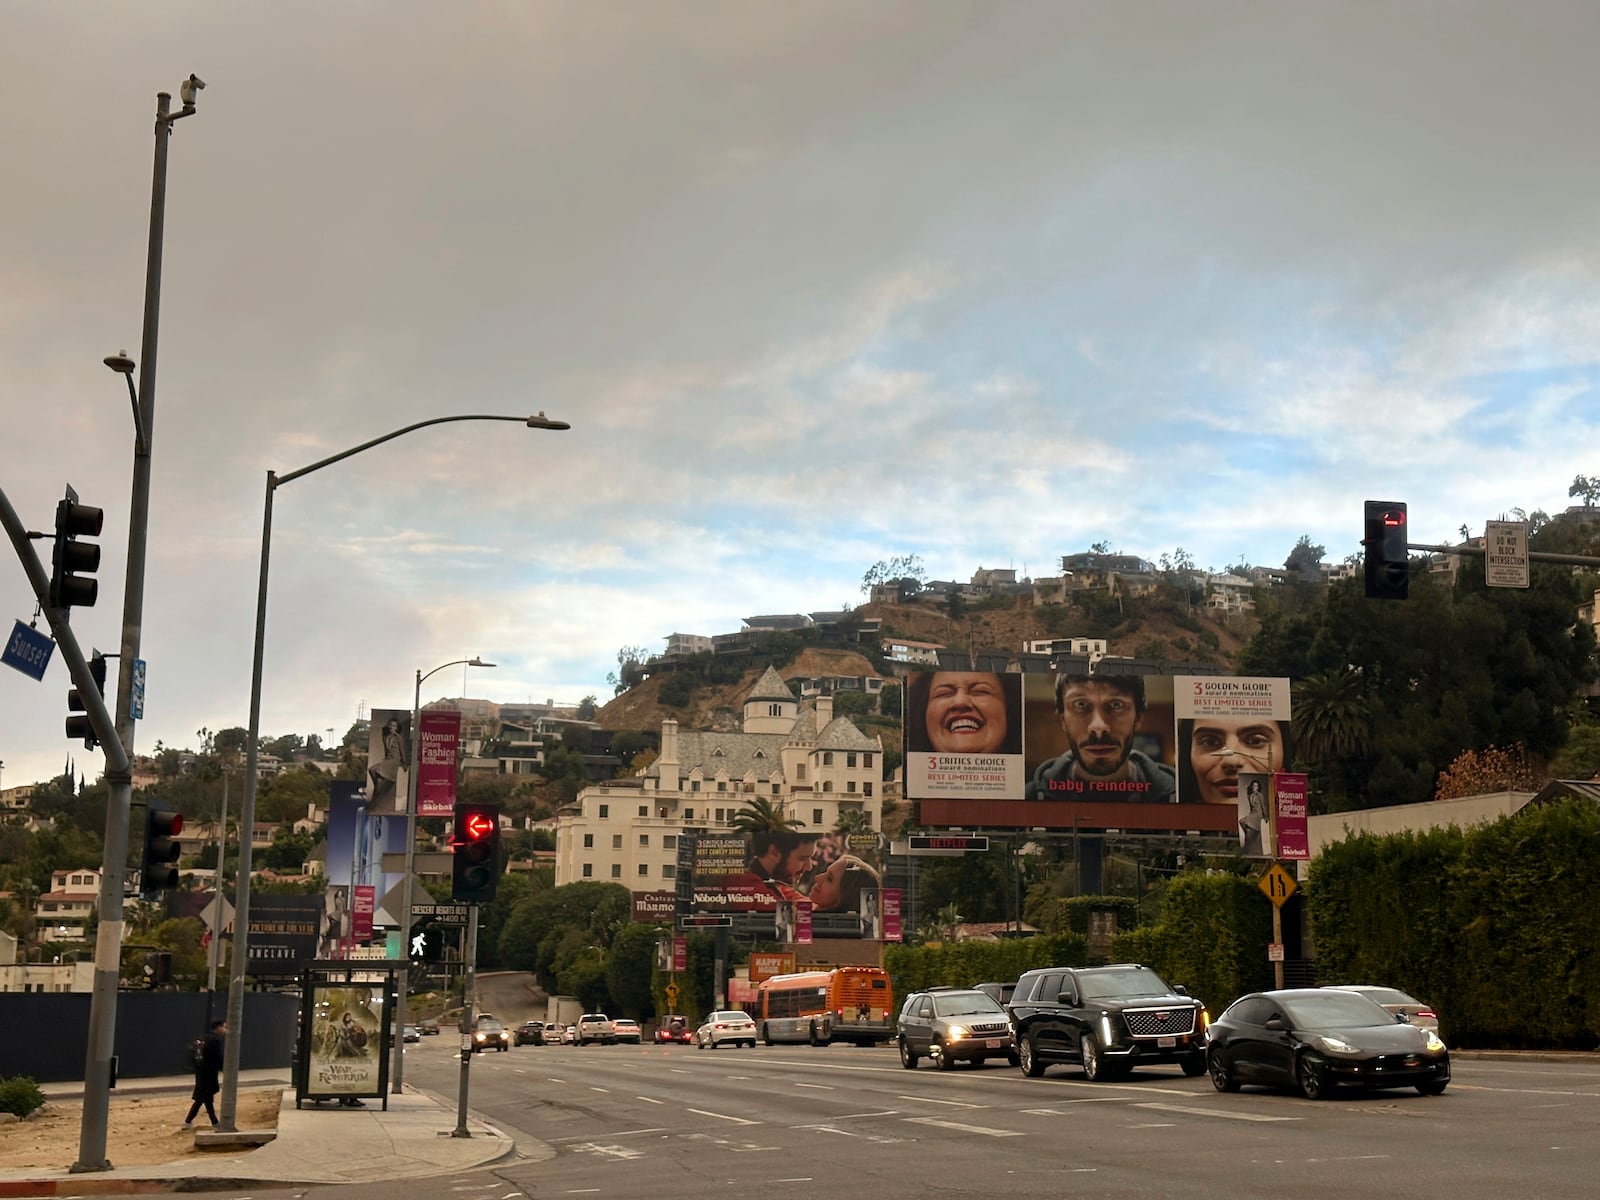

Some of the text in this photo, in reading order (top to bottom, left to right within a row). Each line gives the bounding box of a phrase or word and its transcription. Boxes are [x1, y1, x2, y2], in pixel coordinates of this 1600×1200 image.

[1496, 536, 1517, 546] DO NOT
[1498, 546, 1515, 555] BLOCK
[1489, 556, 1525, 565] INTERSECTION
[11, 632, 48, 668] Sunset
[1193, 682, 1203, 696] 3
[1205, 682, 1238, 690] GOLDEN
[1193, 698, 1211, 706] BEST
[421, 732, 455, 742] Woman
[422, 747, 456, 757] Fashion
[928, 756, 1006, 770] 3 CRITICS CHOICE
[948, 773, 979, 781] LIMITED
[981, 774, 1006, 782] SERIES
[1048, 779, 1152, 793] baby reindeer
[1277, 791, 1304, 800] Woman
[1279, 804, 1306, 812] Fashion
[696, 840, 703, 848] 3
[929, 838, 968, 849] NETFLIX
[690, 893, 727, 905] Nobody
[727, 893, 754, 903] Wants
[248, 948, 296, 958] ONCLAVE
[755, 958, 782, 966] HAPPY
[330, 1065, 353, 1074] WAR
